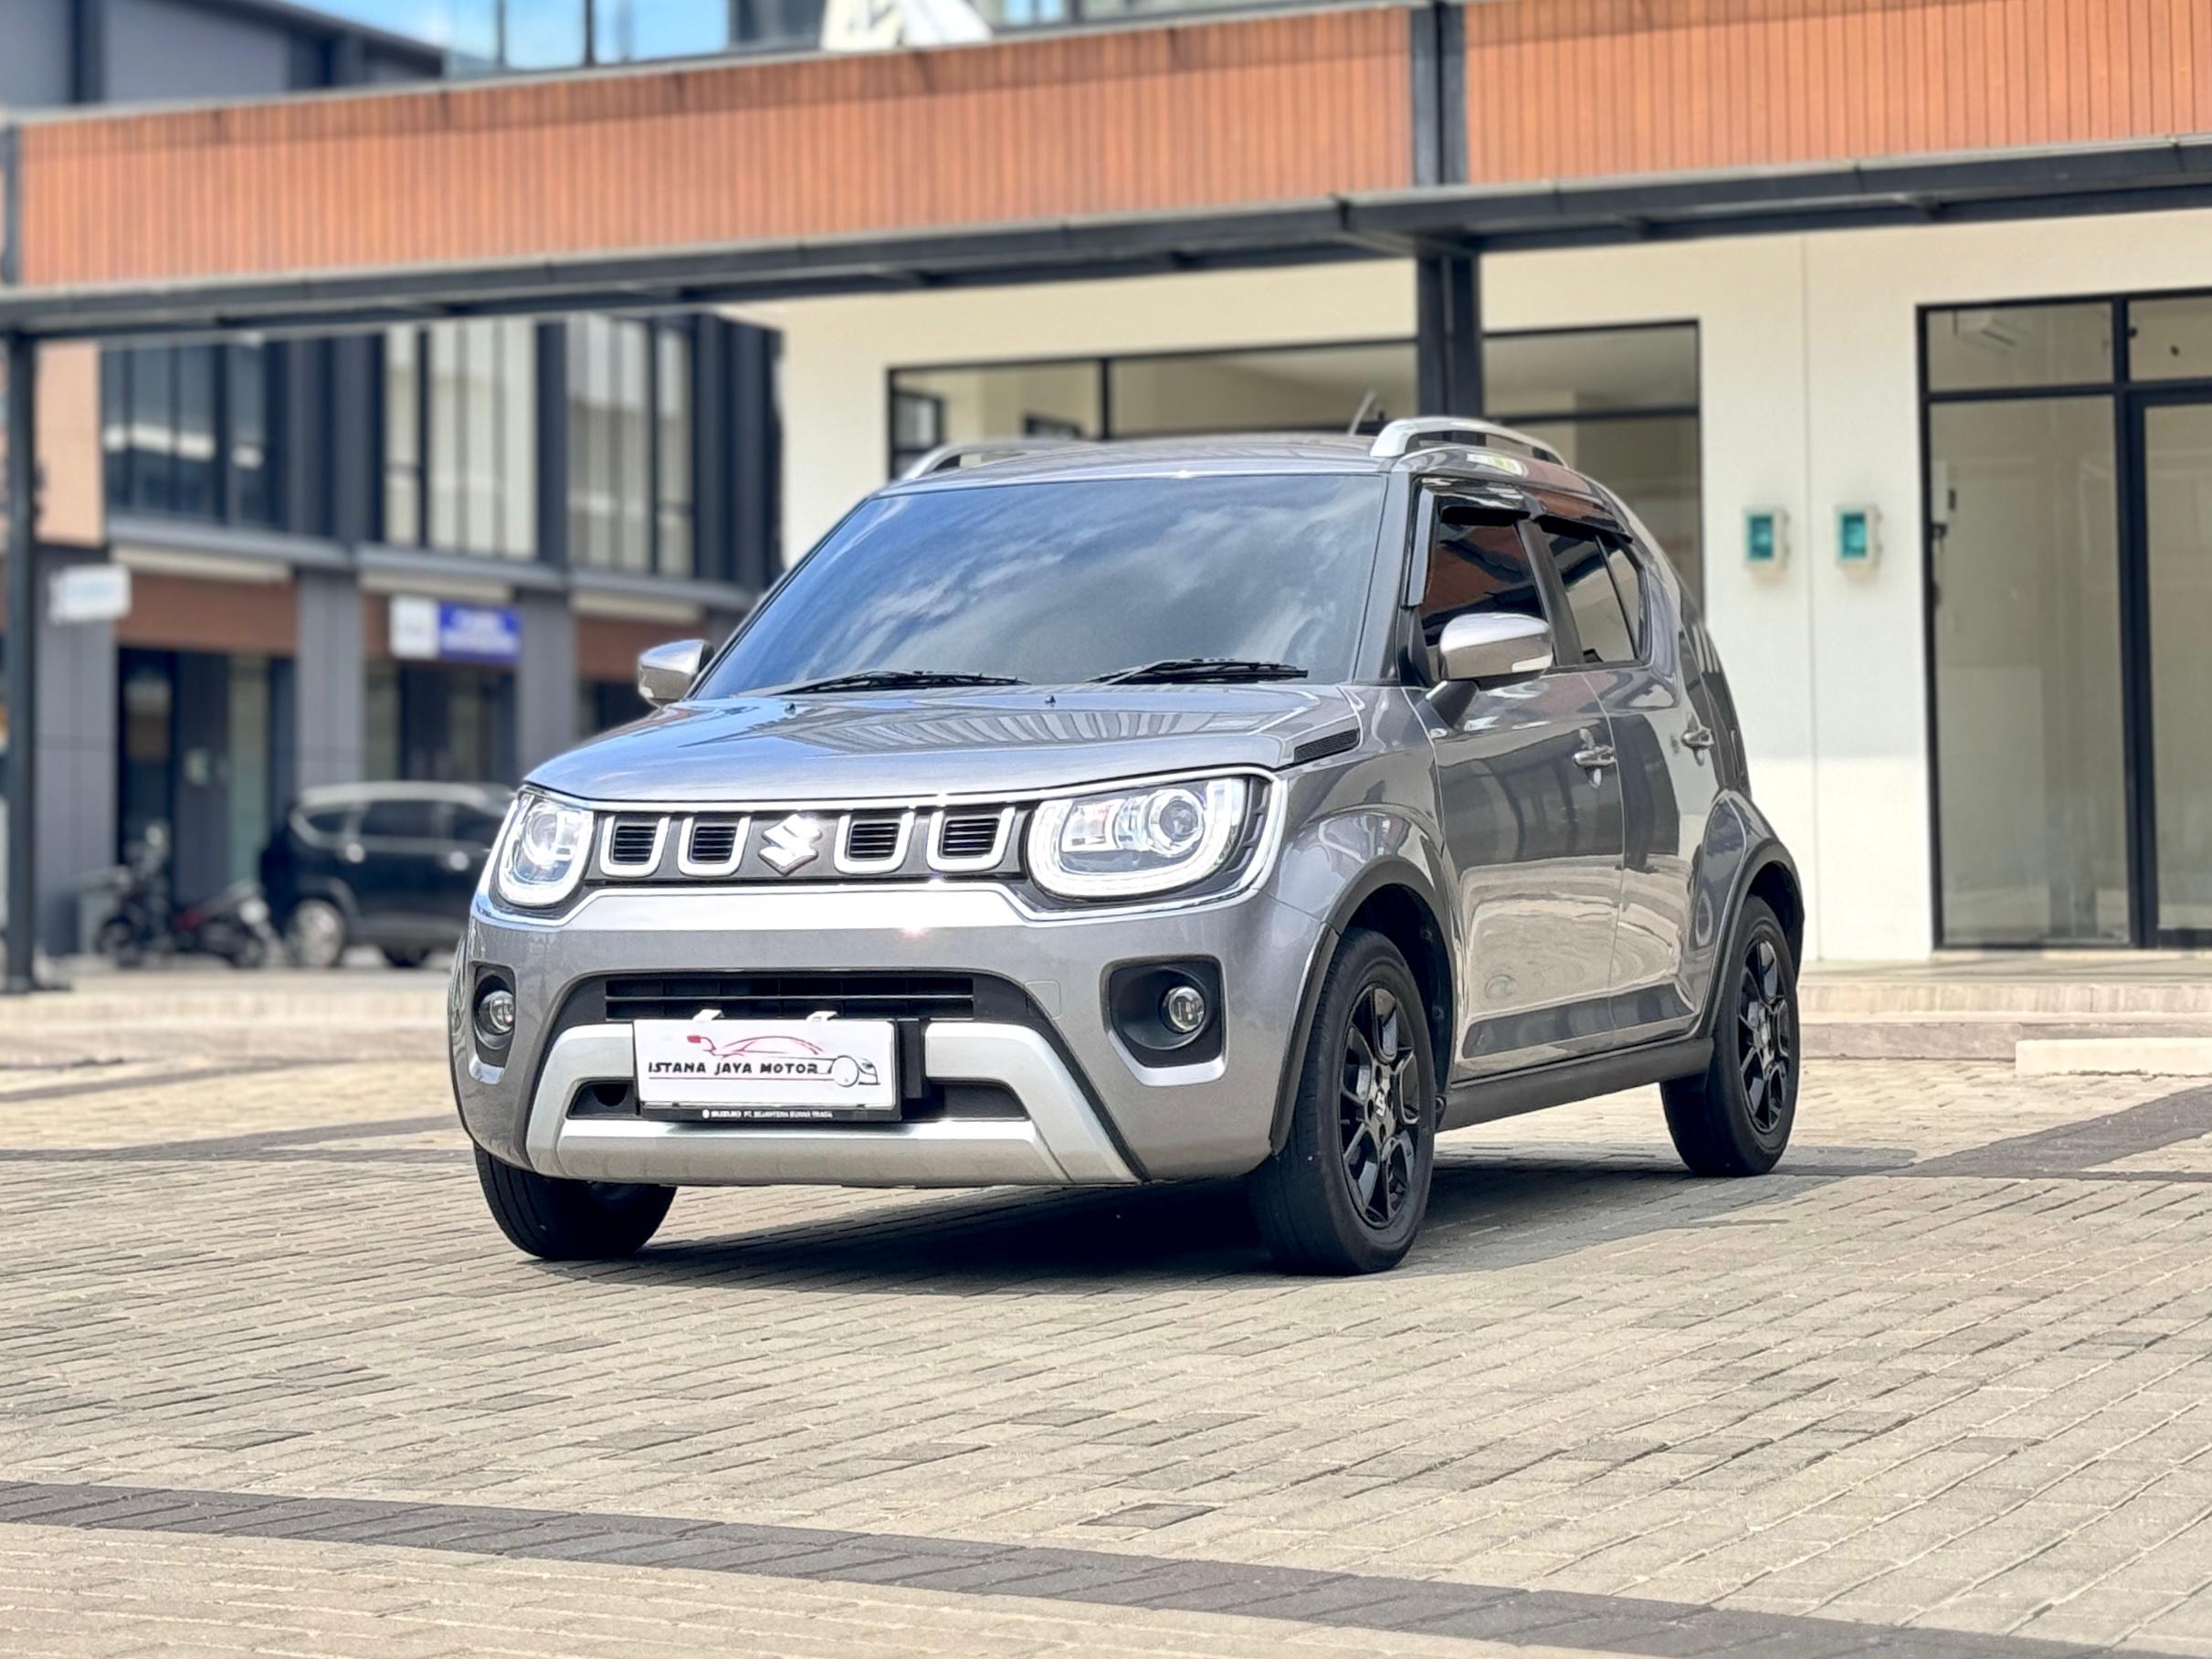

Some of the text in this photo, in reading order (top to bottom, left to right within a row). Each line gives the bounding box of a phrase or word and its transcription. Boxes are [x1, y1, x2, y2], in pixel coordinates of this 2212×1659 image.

[648, 1062, 818, 1076] ISTANA JAYA MOTOR
